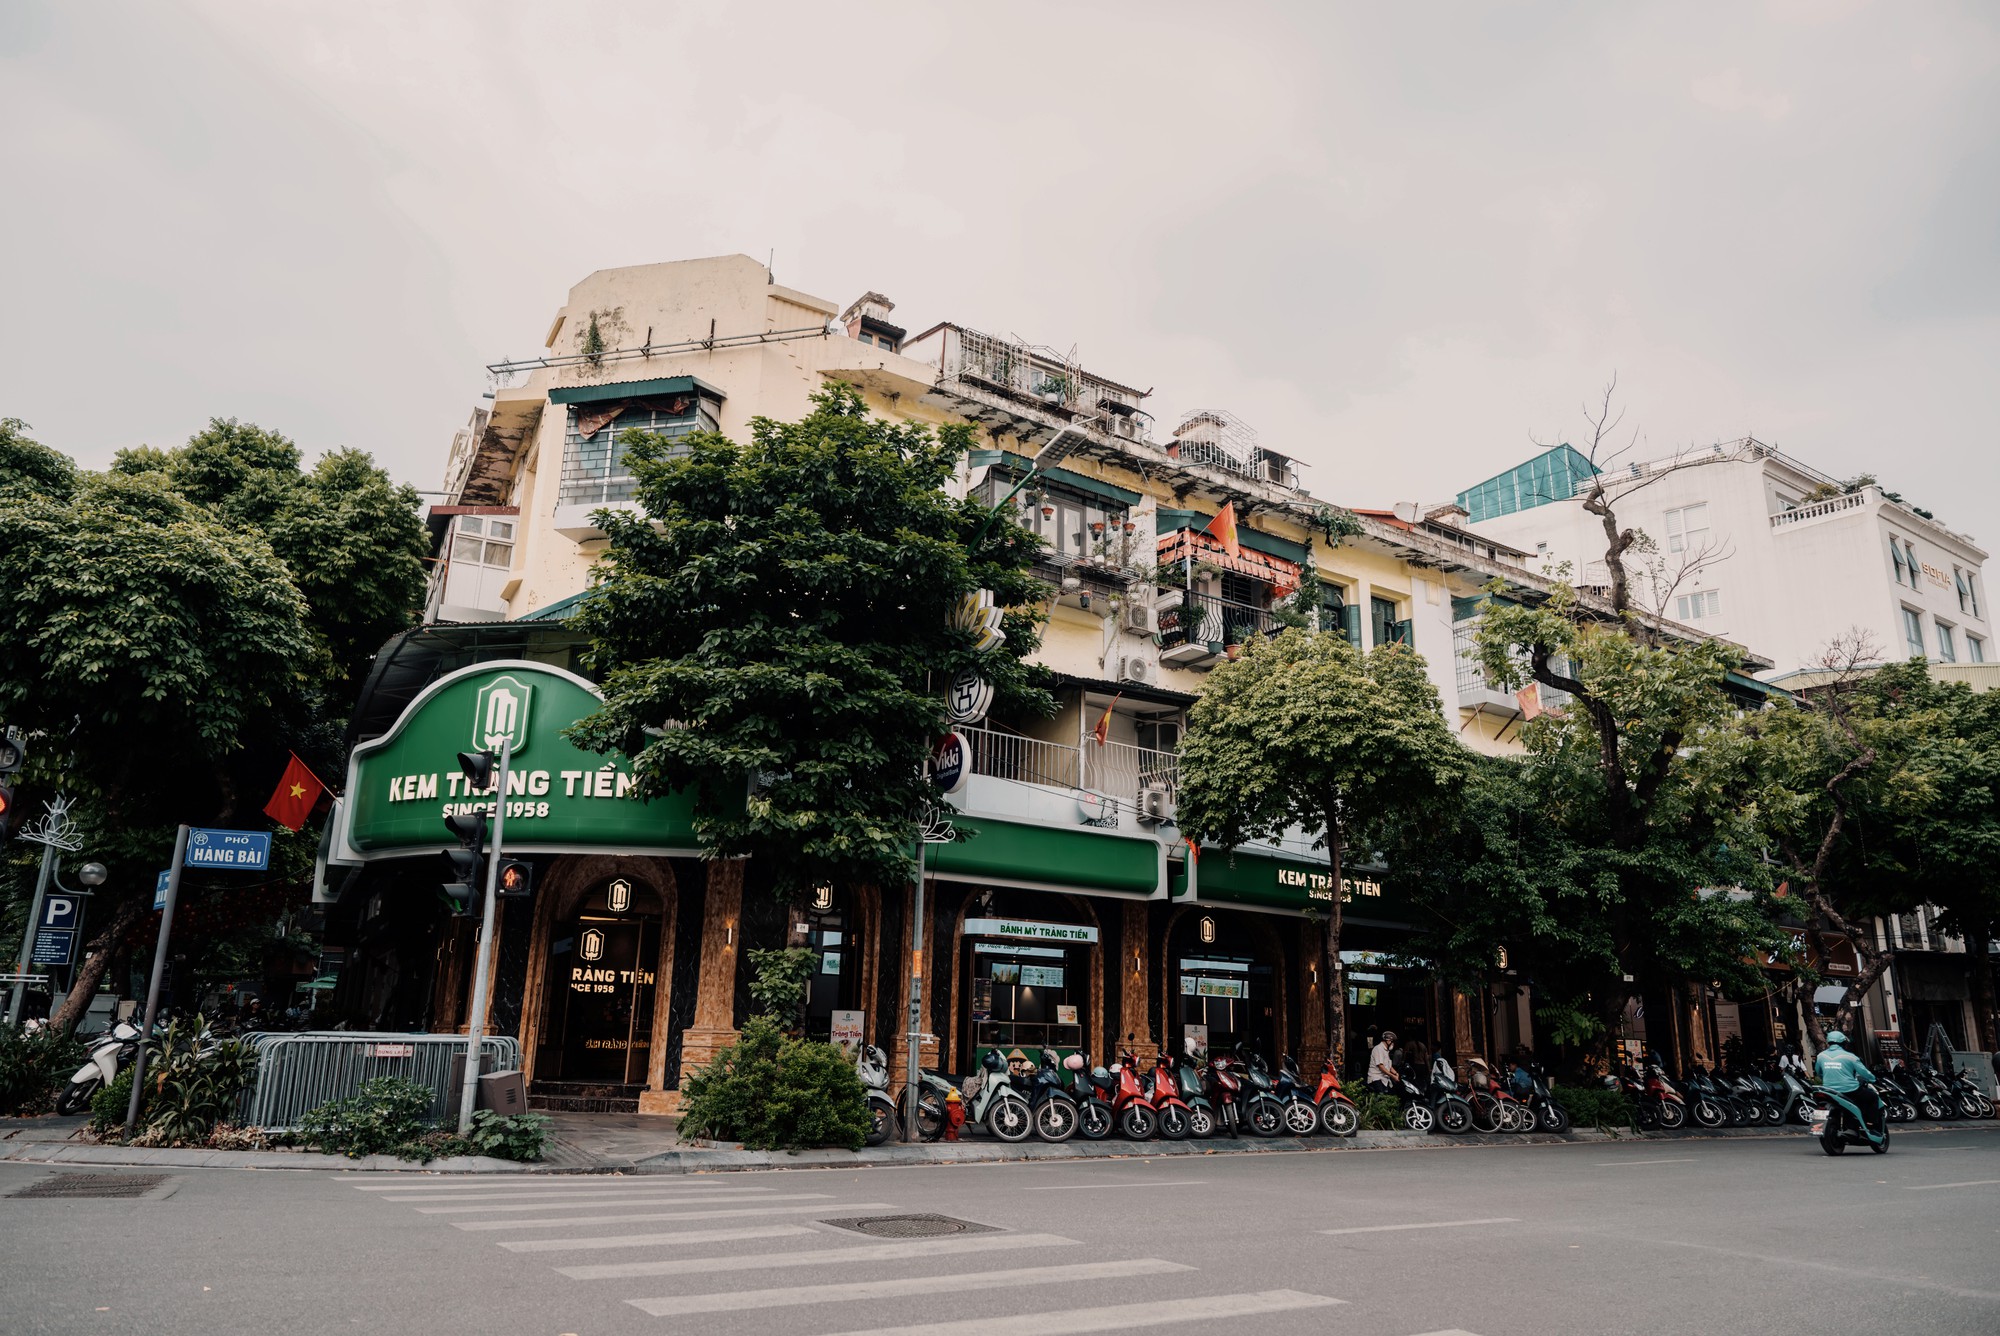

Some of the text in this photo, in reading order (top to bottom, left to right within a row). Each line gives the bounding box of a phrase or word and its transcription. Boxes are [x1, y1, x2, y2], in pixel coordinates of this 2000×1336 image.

[930, 743, 959, 771] Vikki
[388, 773, 438, 802] KEM
[560, 761, 637, 798] TIỀN
[442, 802, 549, 819] SINCE 1958
[225, 834, 249, 844] PHỐ
[194, 845, 262, 864] HÀNG BÀI
[1278, 869, 1307, 887] KEM
[1353, 876, 1380, 897] TIỀN
[1308, 889, 1332, 901] SINCE
[46, 899, 72, 924] P
[1000, 922, 1022, 934] BÁNH
[1040, 926, 1067, 938] TRÀNG
[1069, 928, 1088, 940] TIỀN
[572, 964, 615, 982] RÀNG
[571, 983, 614, 993] NCE 1958
